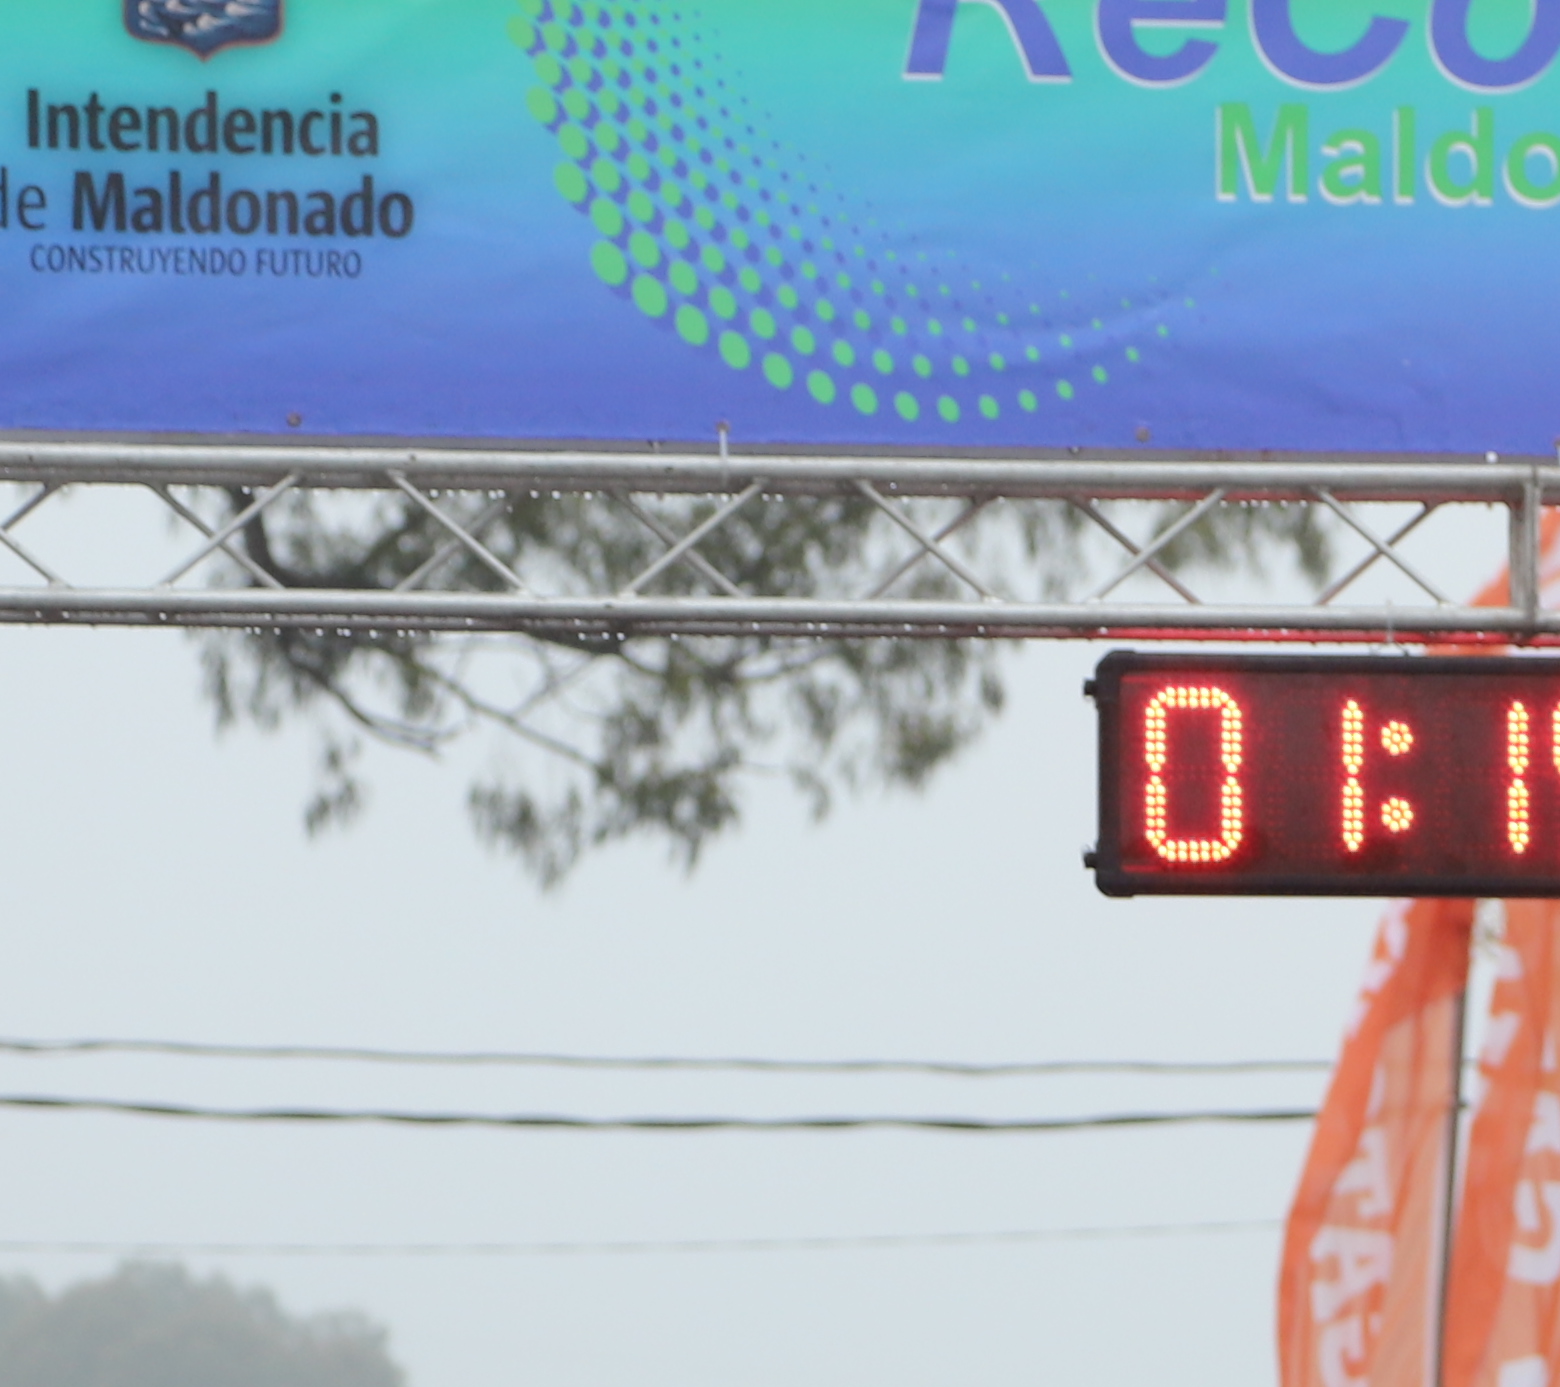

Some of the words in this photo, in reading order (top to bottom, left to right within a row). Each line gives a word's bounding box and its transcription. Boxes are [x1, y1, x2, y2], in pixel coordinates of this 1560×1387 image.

[26, 87, 380, 157] Intendencia
[71, 169, 415, 238] Maldonado
[30, 244, 247, 277] CONSTRUYENDO
[256, 249, 362, 278] FUTURO
